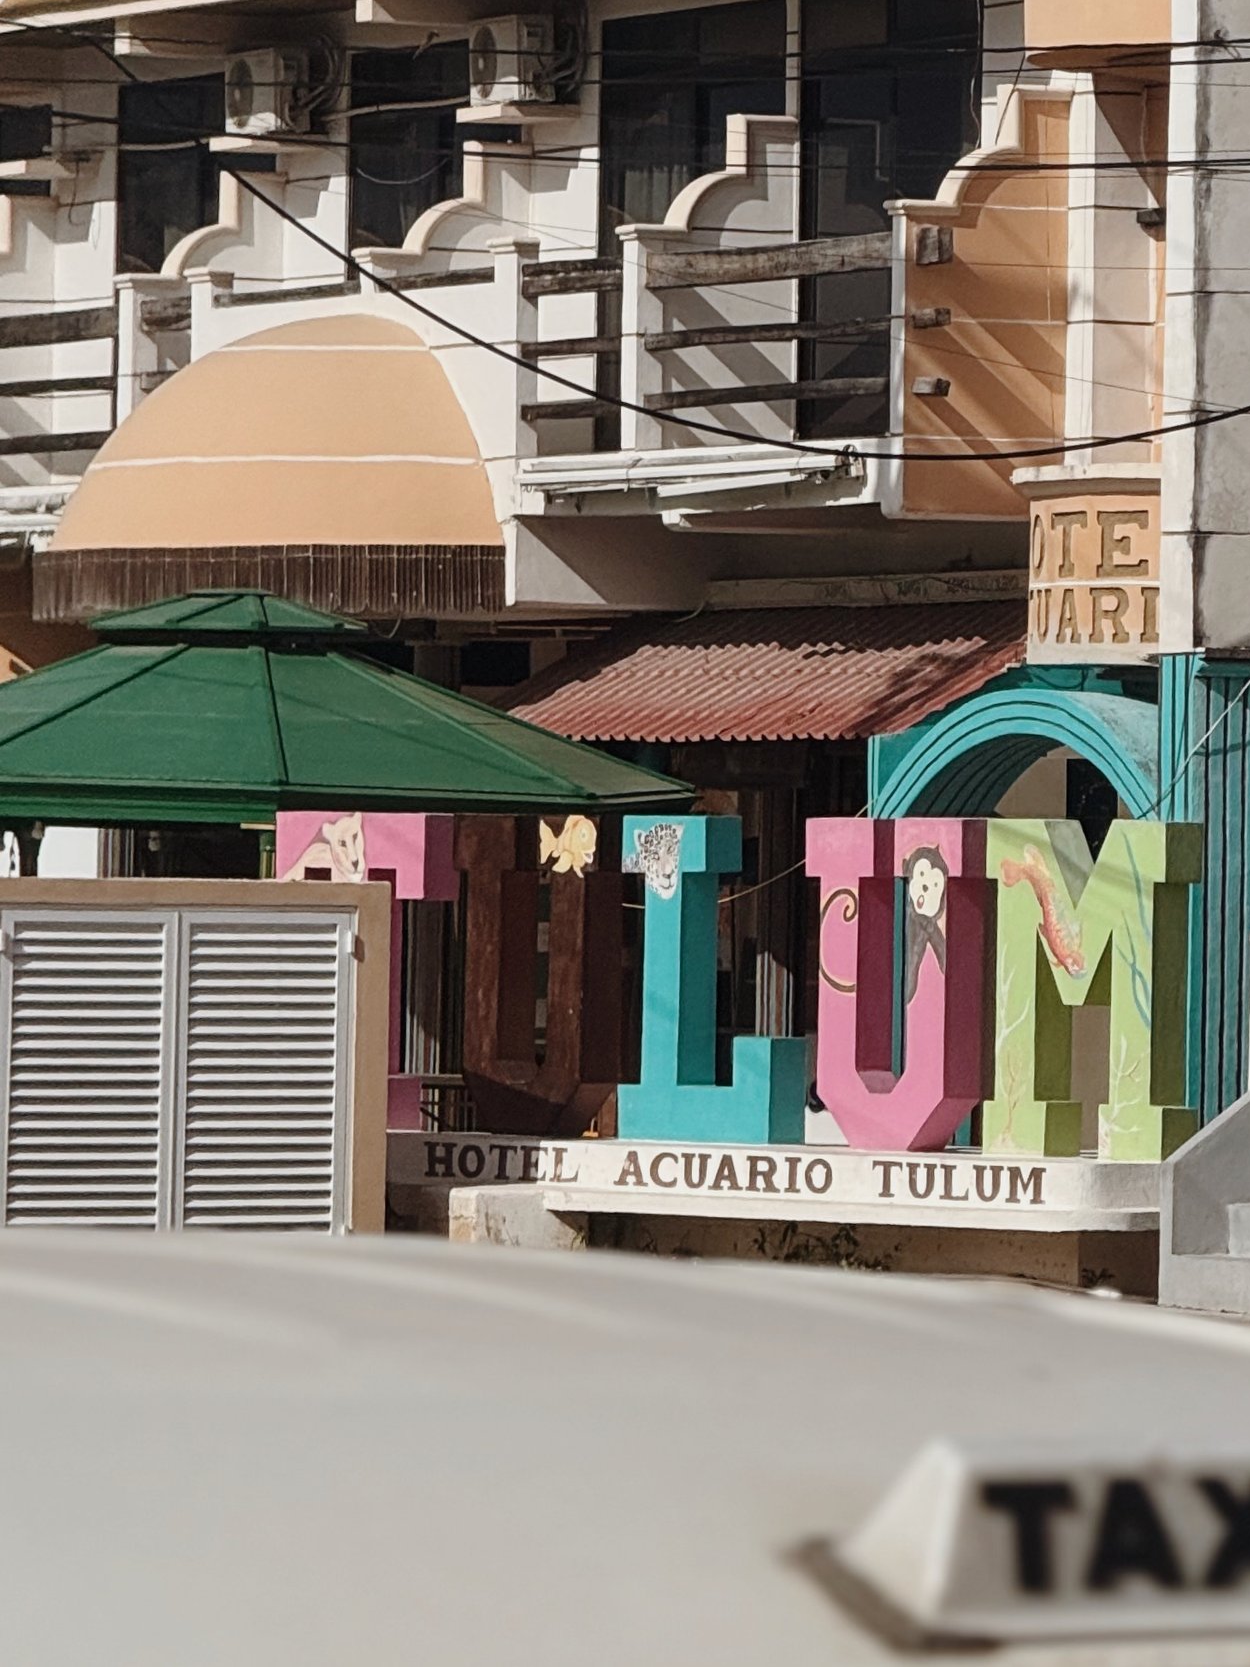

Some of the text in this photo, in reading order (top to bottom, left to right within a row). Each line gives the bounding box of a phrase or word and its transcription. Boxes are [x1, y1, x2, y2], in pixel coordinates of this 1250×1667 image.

[1029, 586, 1160, 644] UARI
[423, 1140, 1047, 1205] HOTEL ACUARIO TULUM
